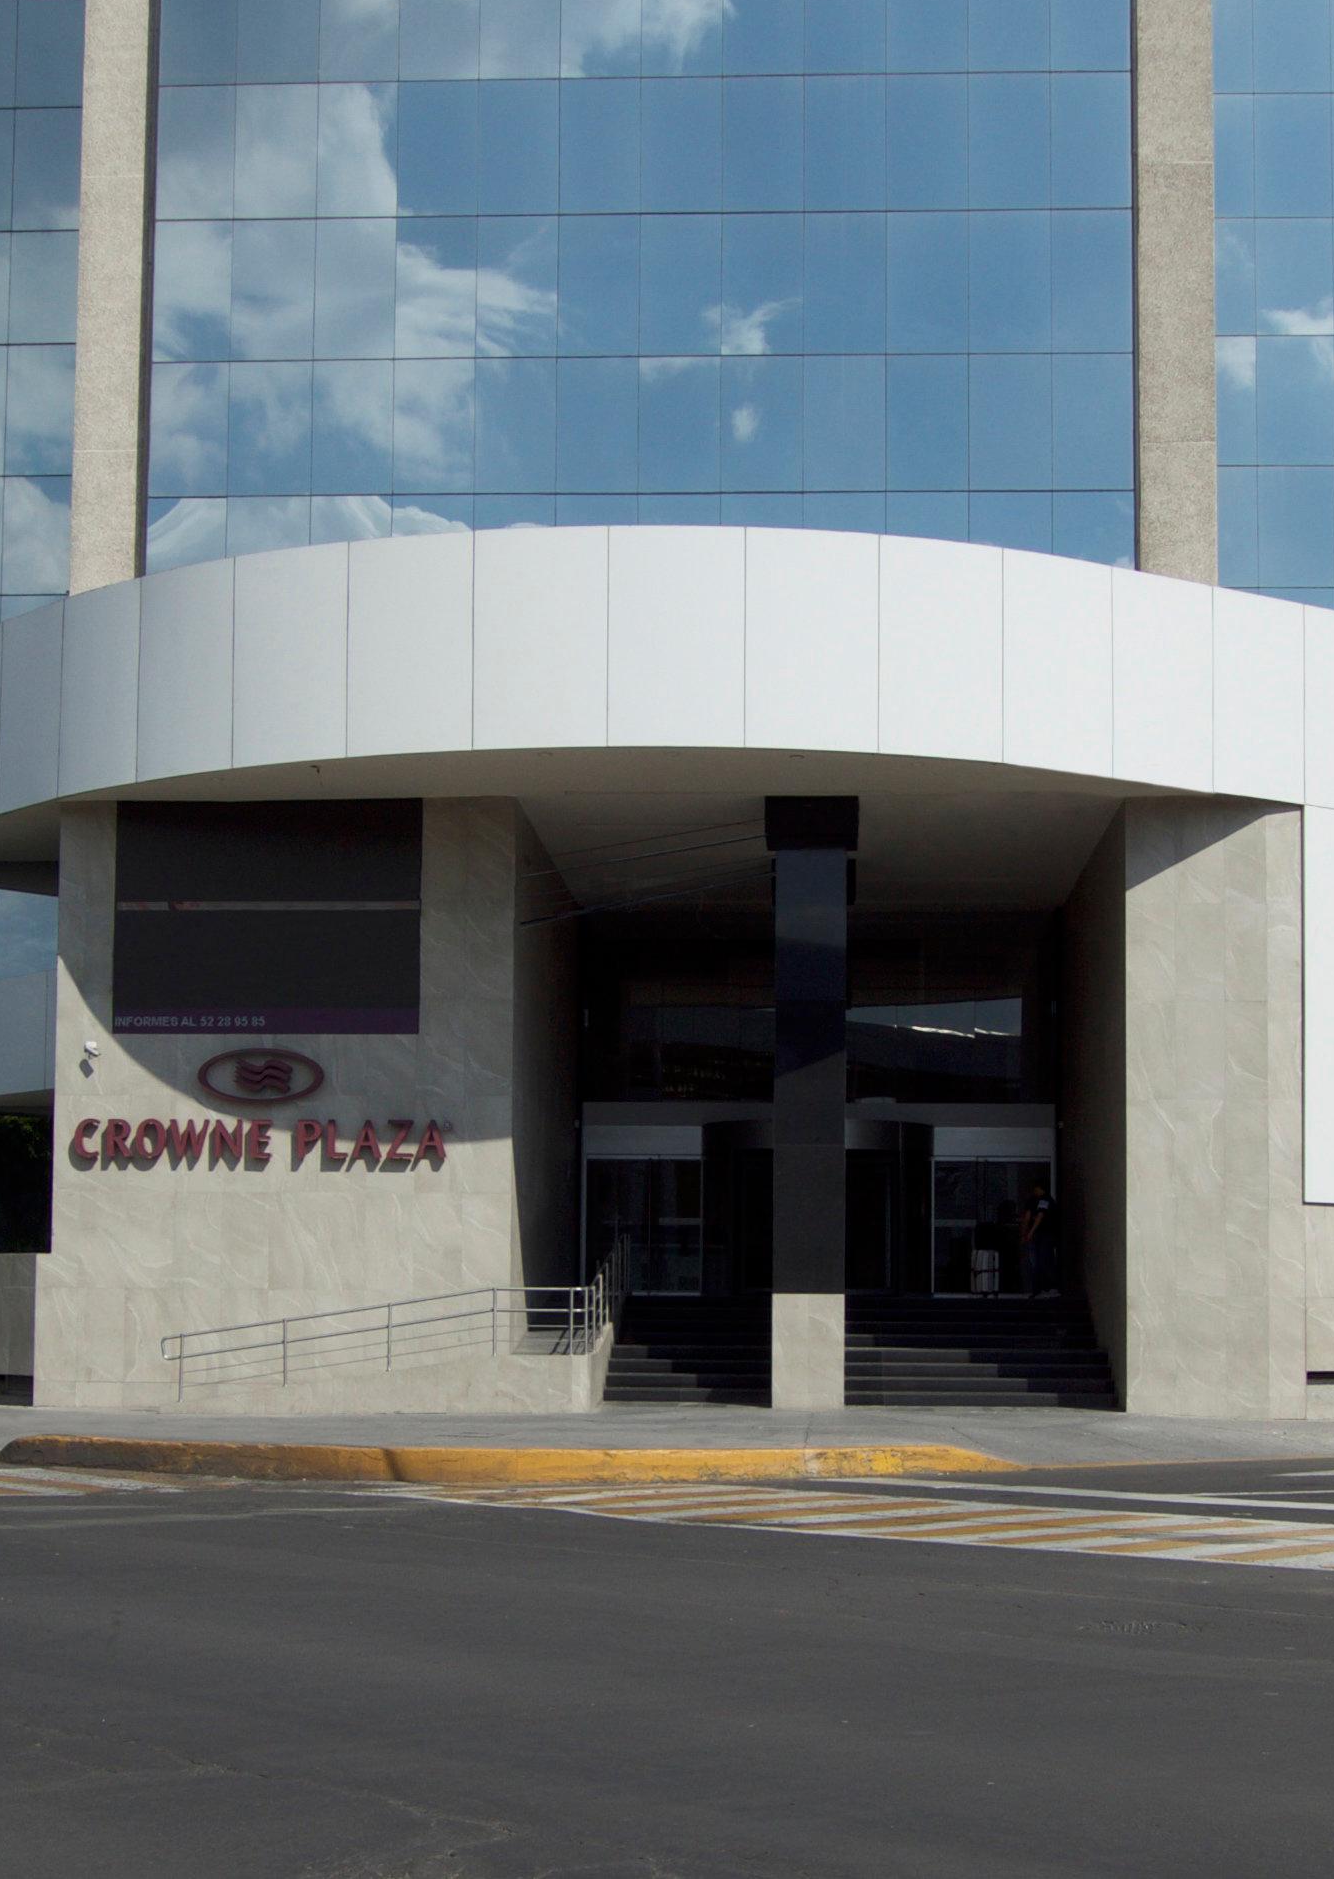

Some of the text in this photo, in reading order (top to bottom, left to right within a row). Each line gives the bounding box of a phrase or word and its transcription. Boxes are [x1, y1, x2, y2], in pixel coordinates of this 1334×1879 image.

[114, 1016, 179, 1027] INFORMES
[180, 1016, 196, 1027] AL
[200, 1016, 214, 1027] 52
[216, 1016, 231, 1027] 28
[250, 1016, 265, 1027] 85
[72, 1117, 447, 1160] CROWNE PLAZA
